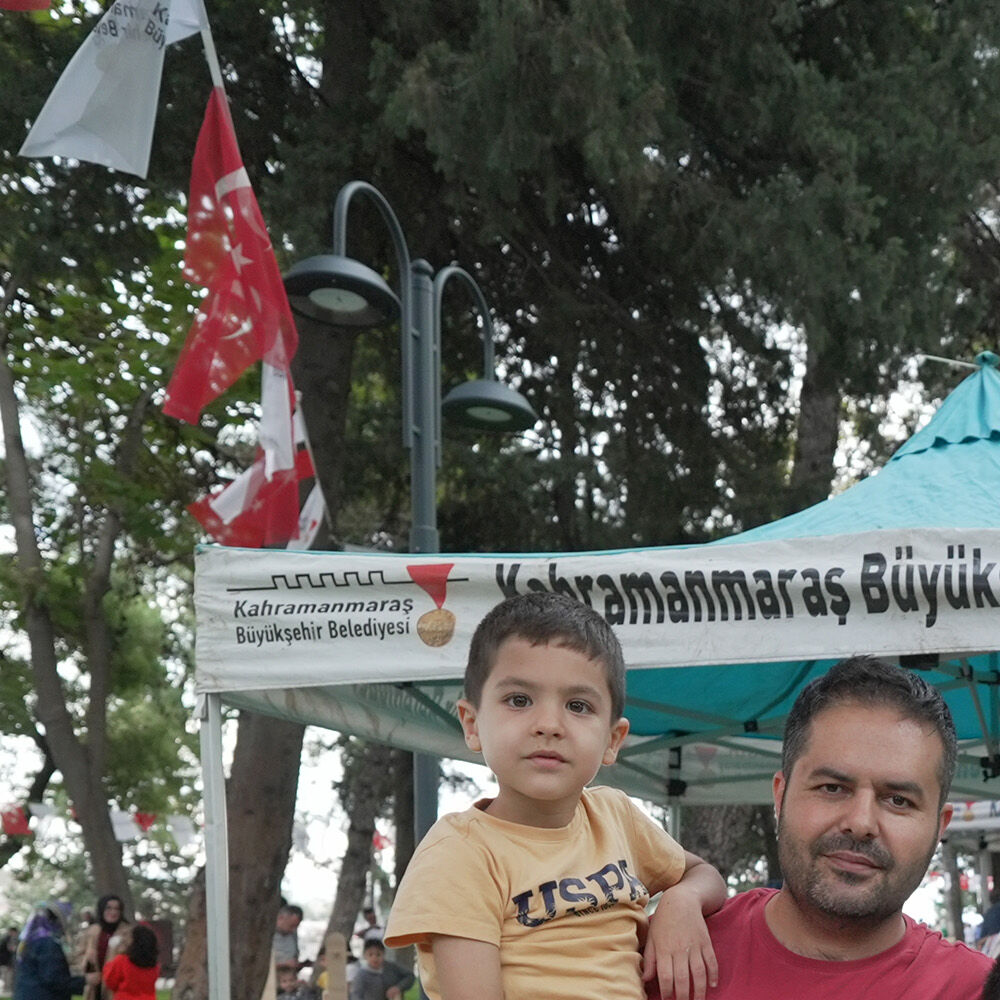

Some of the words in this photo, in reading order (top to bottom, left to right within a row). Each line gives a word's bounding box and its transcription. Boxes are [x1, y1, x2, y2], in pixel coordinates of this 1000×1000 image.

[233, 598, 415, 619] Kahramanmaraş
[236, 621, 323, 648] Büyükşehir
[328, 617, 411, 641] Belediyesi
